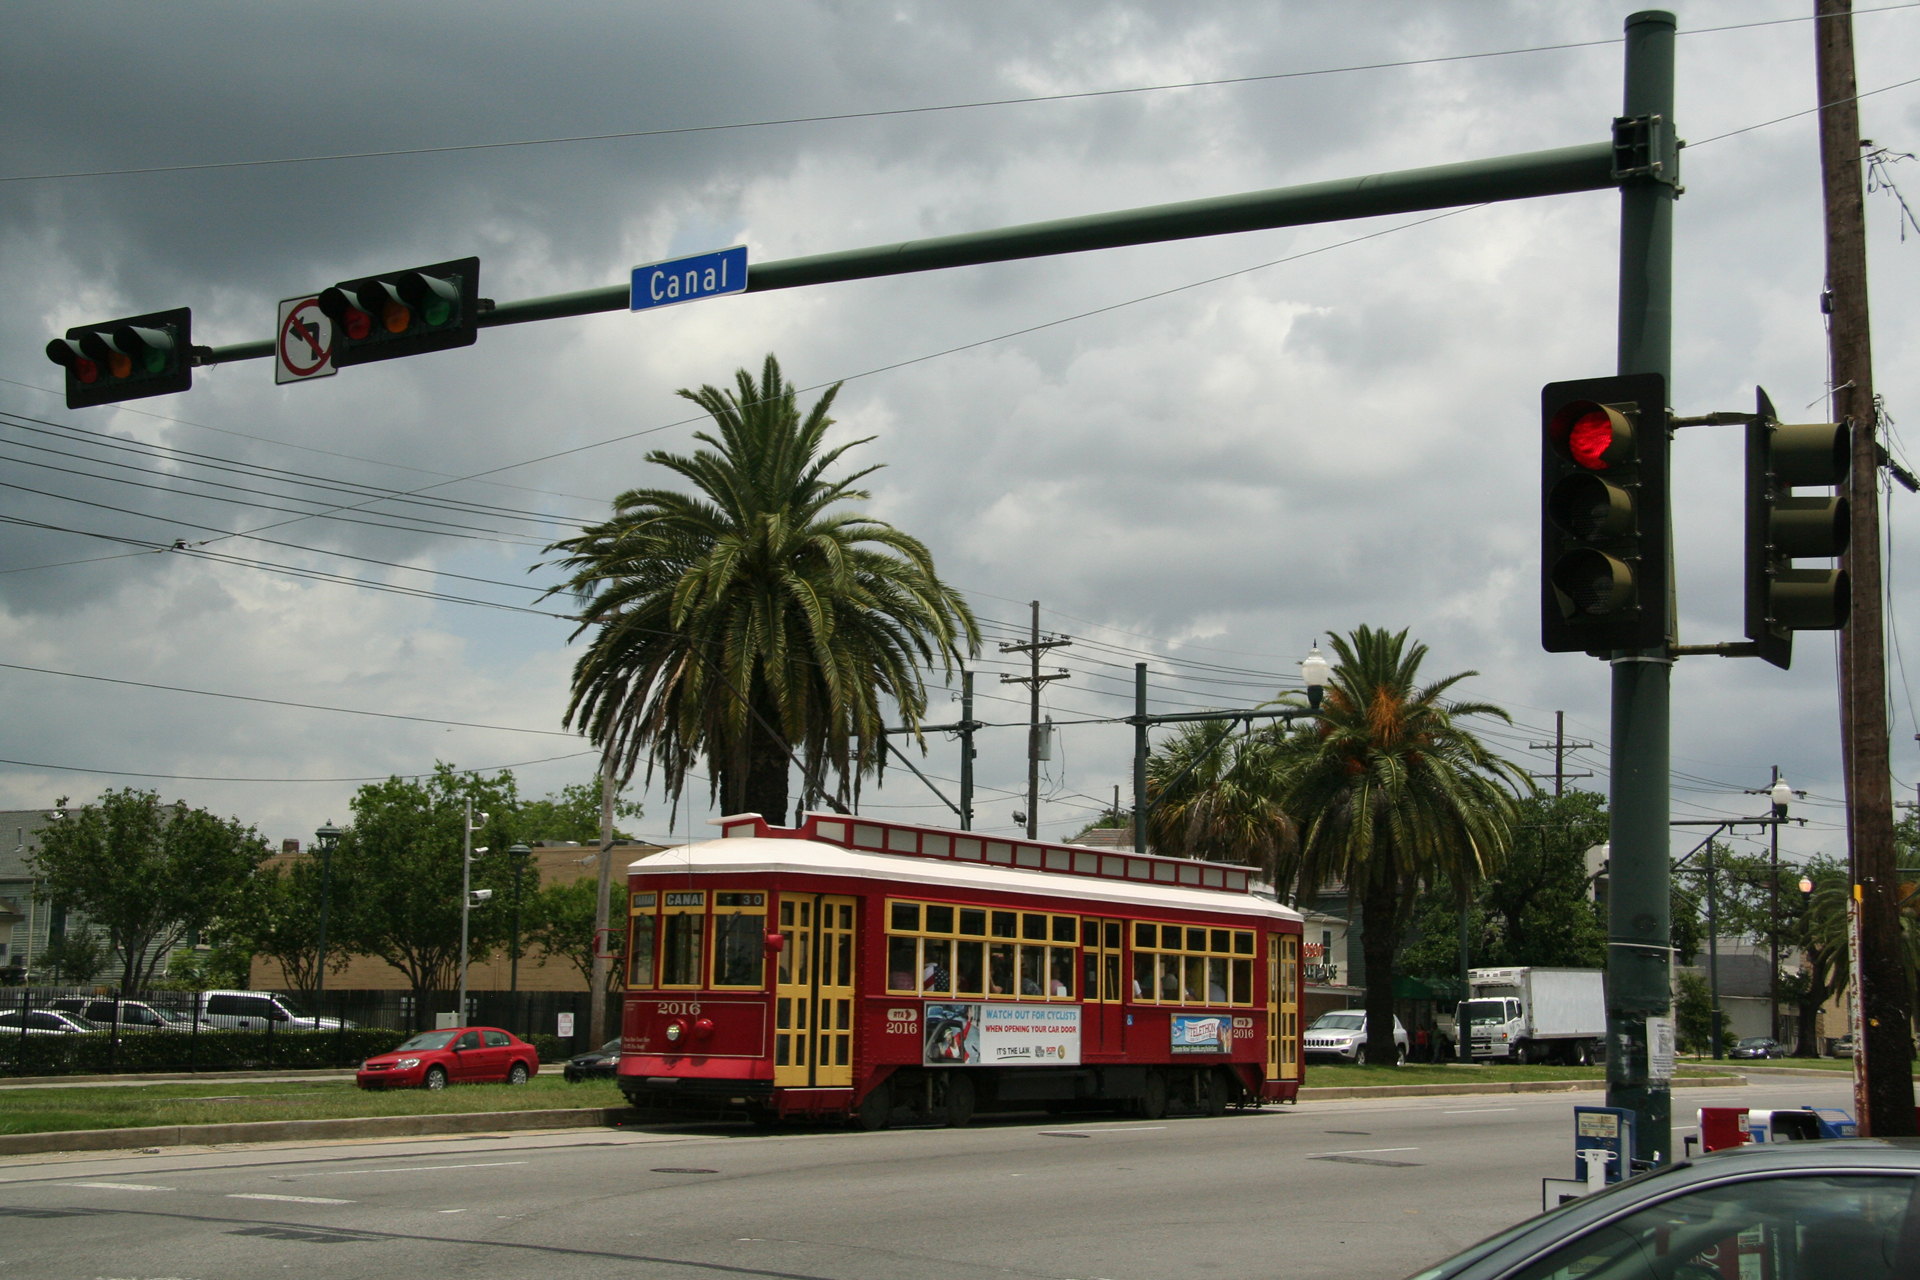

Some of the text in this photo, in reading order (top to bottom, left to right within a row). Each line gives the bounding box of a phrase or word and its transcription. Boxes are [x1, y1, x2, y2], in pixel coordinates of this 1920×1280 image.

[650, 258, 727, 301] Canal
[666, 894, 704, 905] CANAL
[743, 895, 762, 905] 30
[657, 1002, 701, 1015] 2016
[986, 1010, 1076, 1020] WATCH OUT FOR CYCLISTS
[886, 1022, 917, 1034] 2016
[1004, 1025, 1030, 1033] OPENING
[1190, 1023, 1216, 1037] TELETHON
[1233, 1029, 1254, 1038] 2016
[997, 1047, 1006, 1055] IT'S
